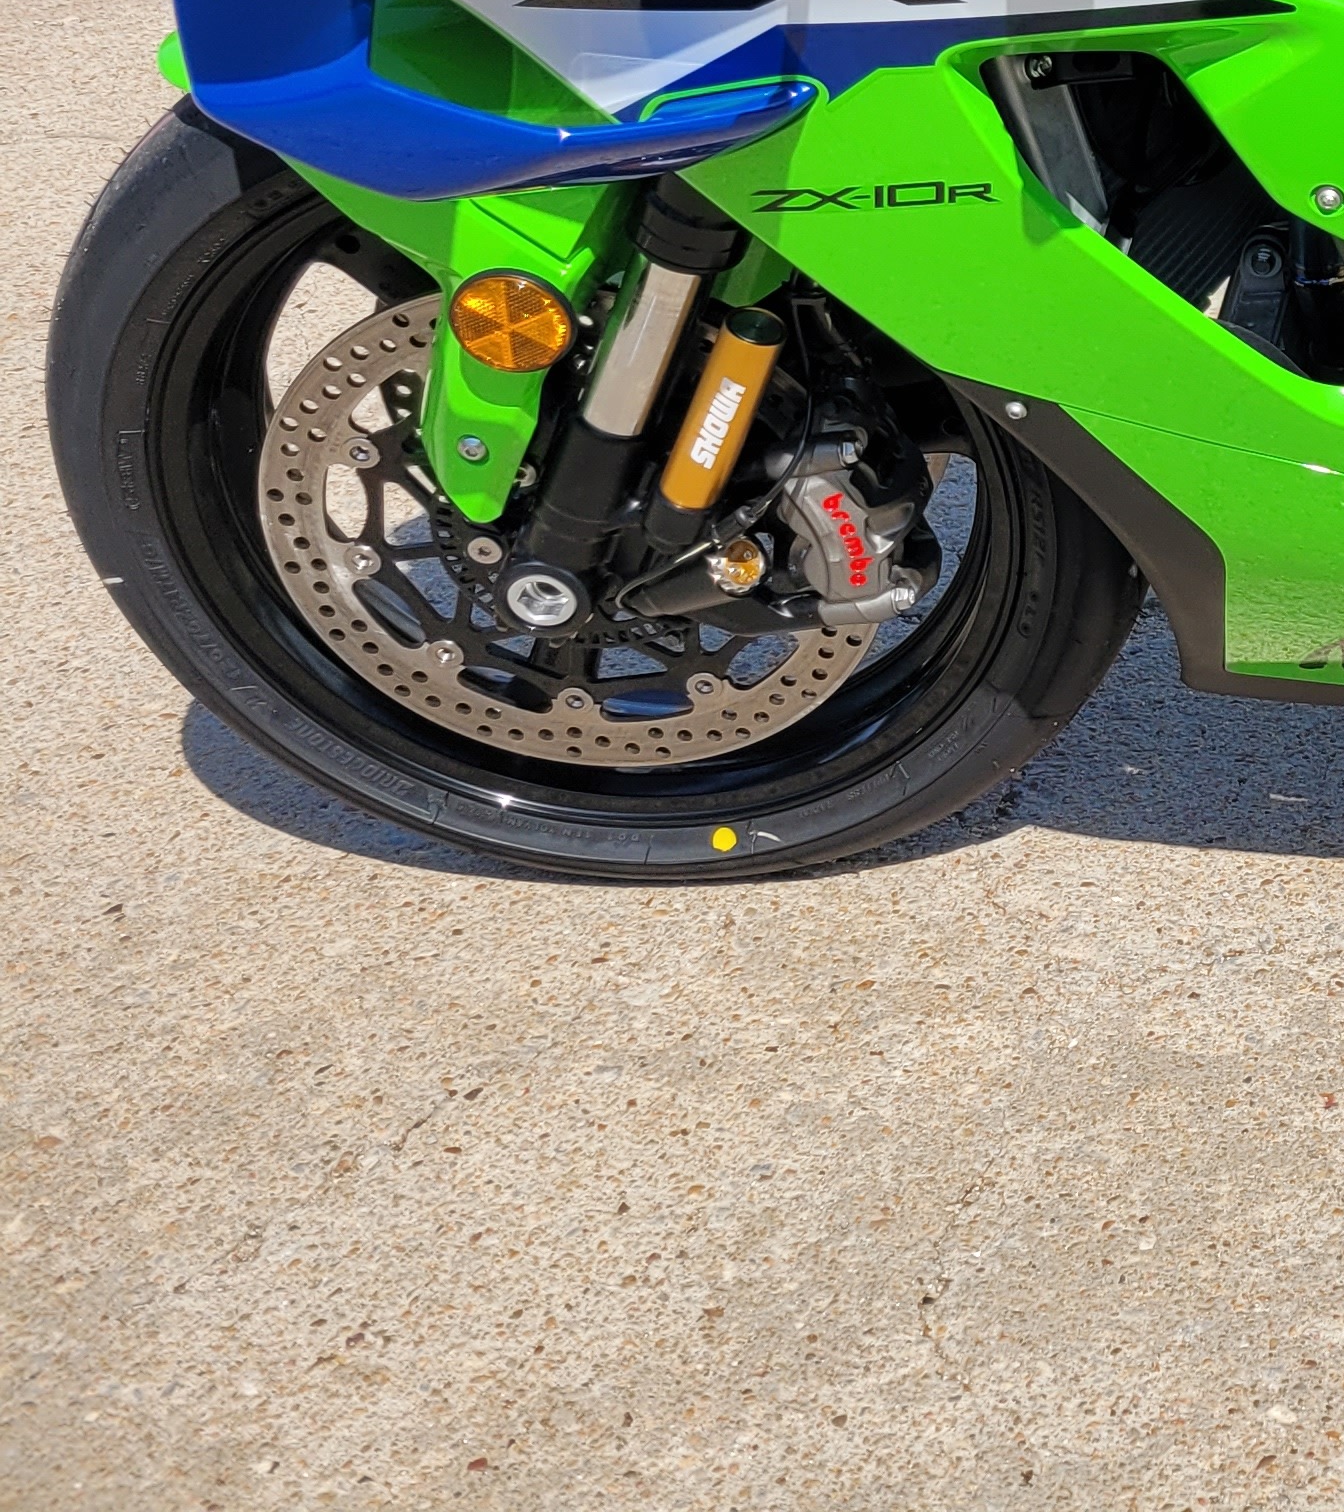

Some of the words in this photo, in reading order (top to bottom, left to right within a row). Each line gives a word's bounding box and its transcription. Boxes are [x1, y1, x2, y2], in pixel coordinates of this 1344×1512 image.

[751, 178, 1002, 214] ZX-10R
[690, 376, 748, 470] SHOWA
[821, 492, 869, 587] brembo
